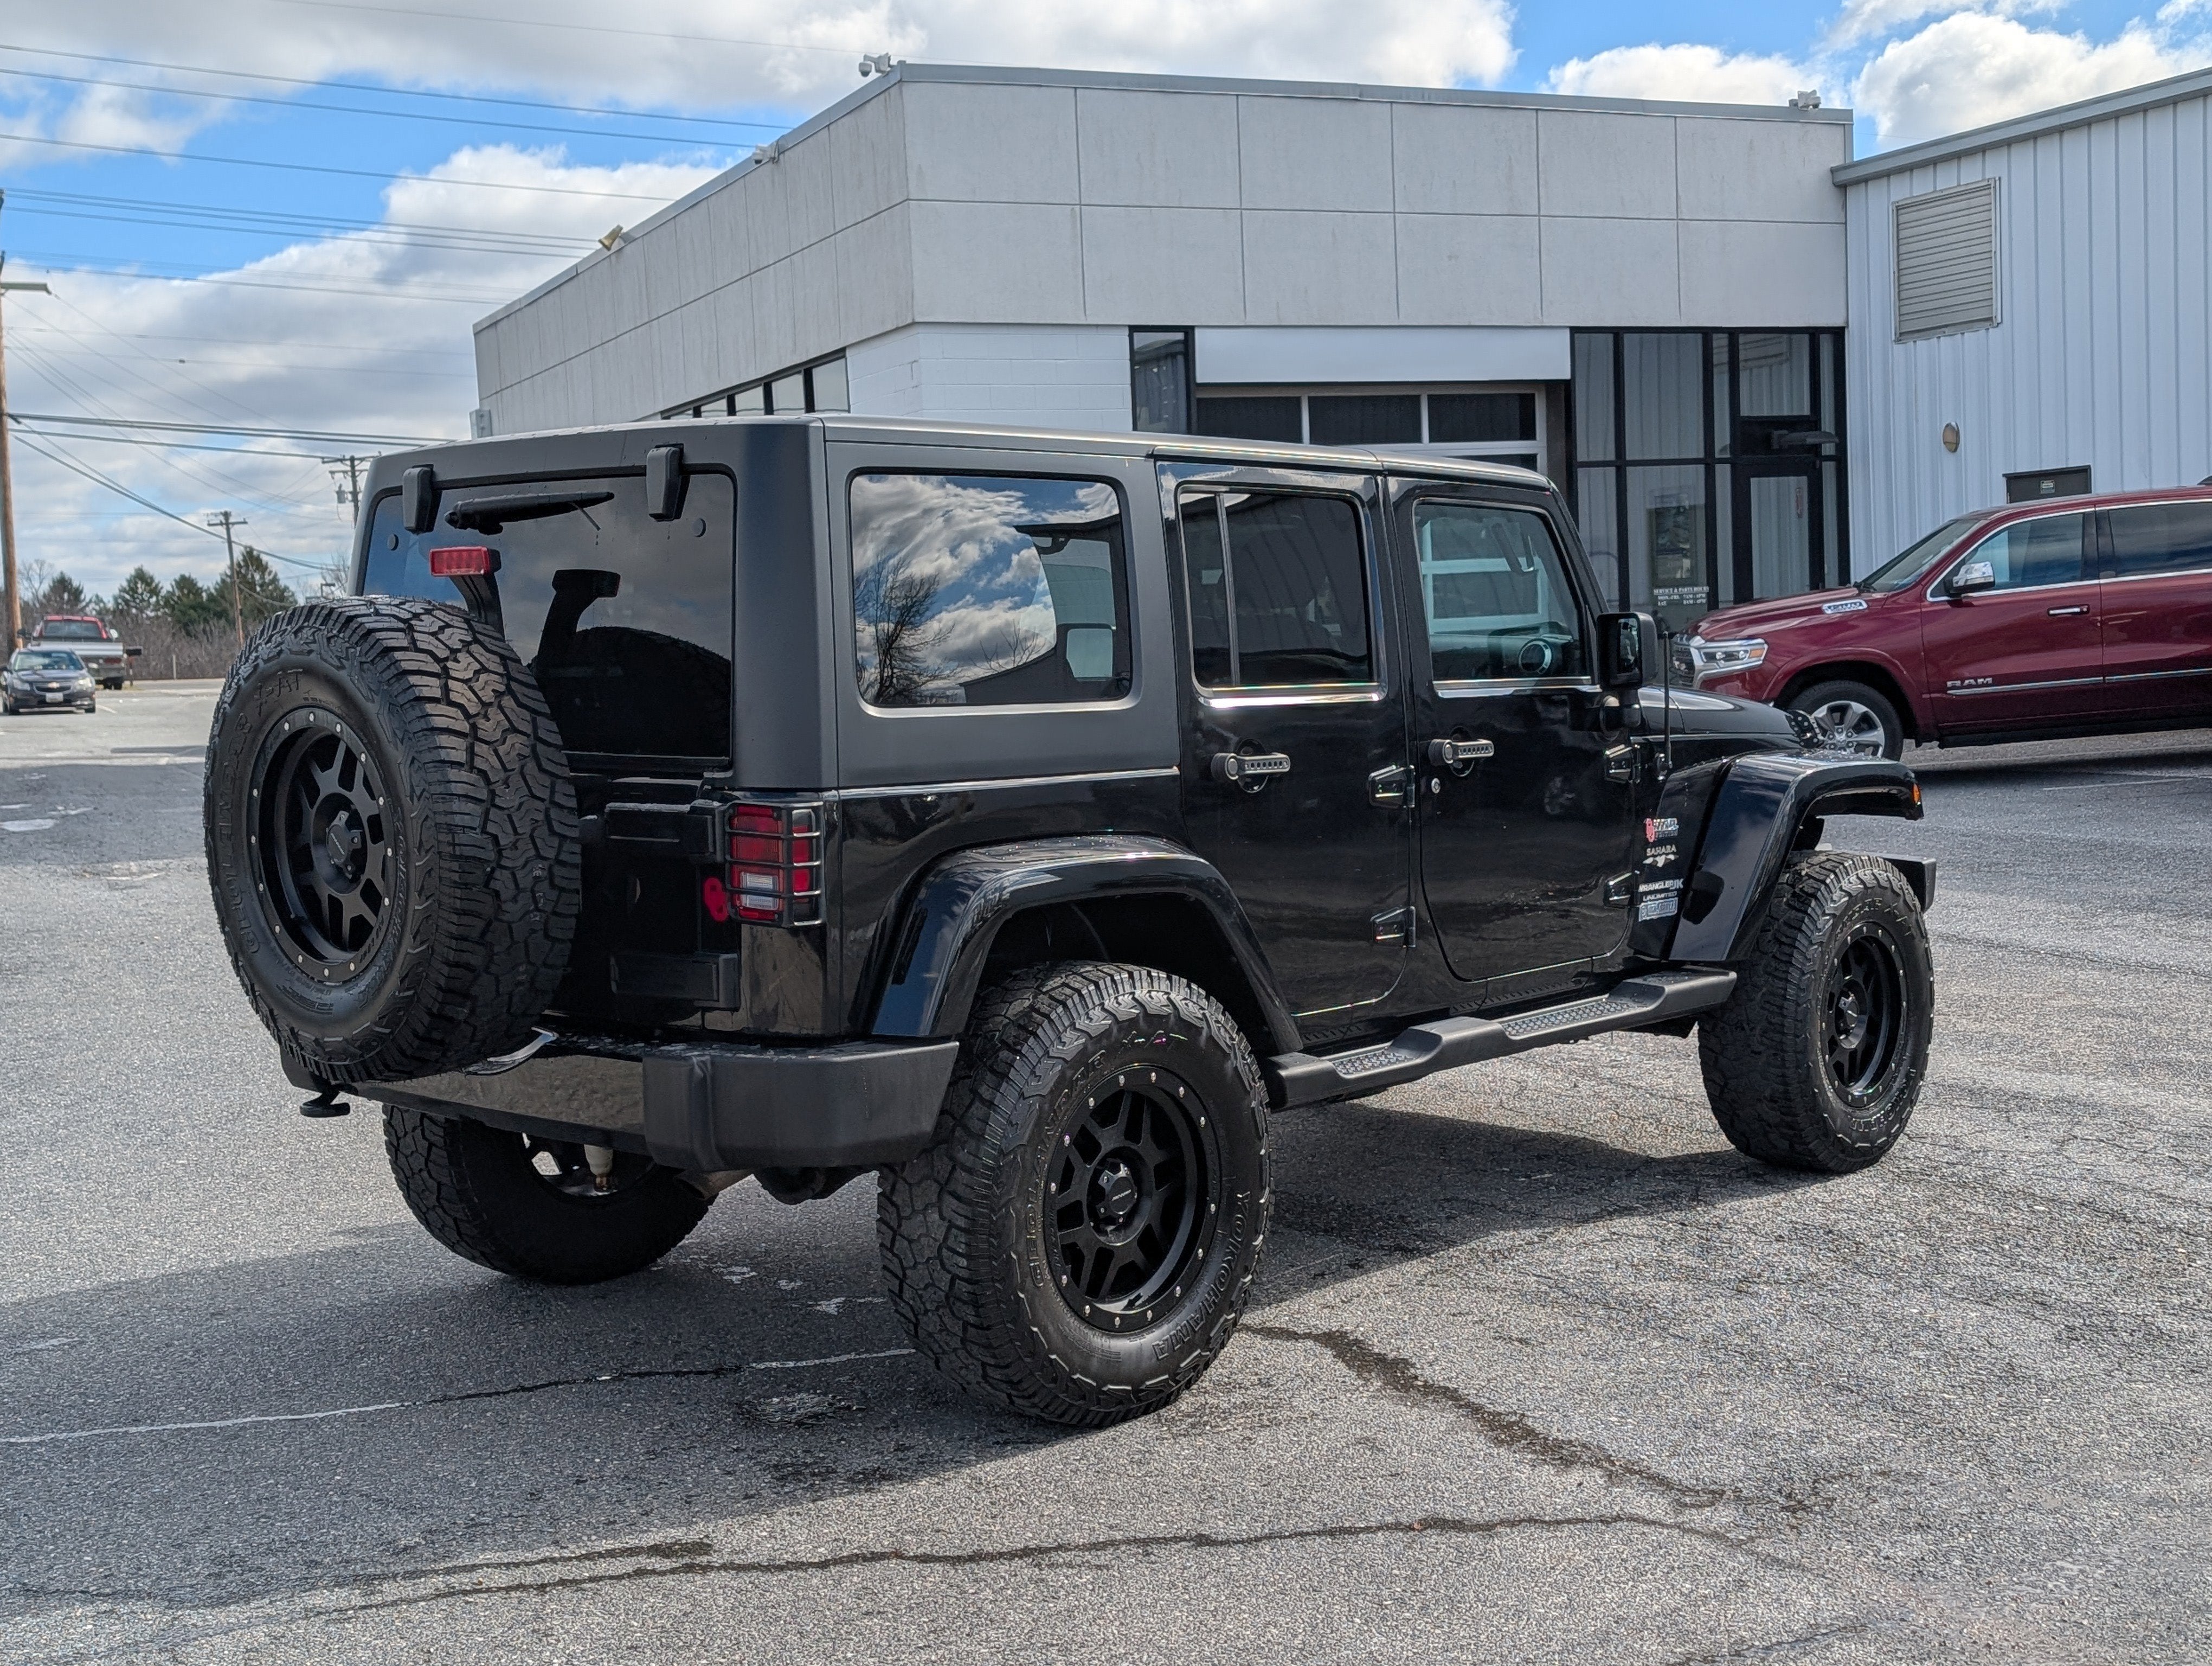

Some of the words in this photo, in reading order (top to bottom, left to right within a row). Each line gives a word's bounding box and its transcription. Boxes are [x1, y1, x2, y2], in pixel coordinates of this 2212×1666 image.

[1946, 677, 1992, 688] RAM
[1646, 844, 1677, 856] SAHARA
[1643, 890, 1677, 902] UNLIMITED
[1152, 1191, 1251, 1360] YOKOHAMA
